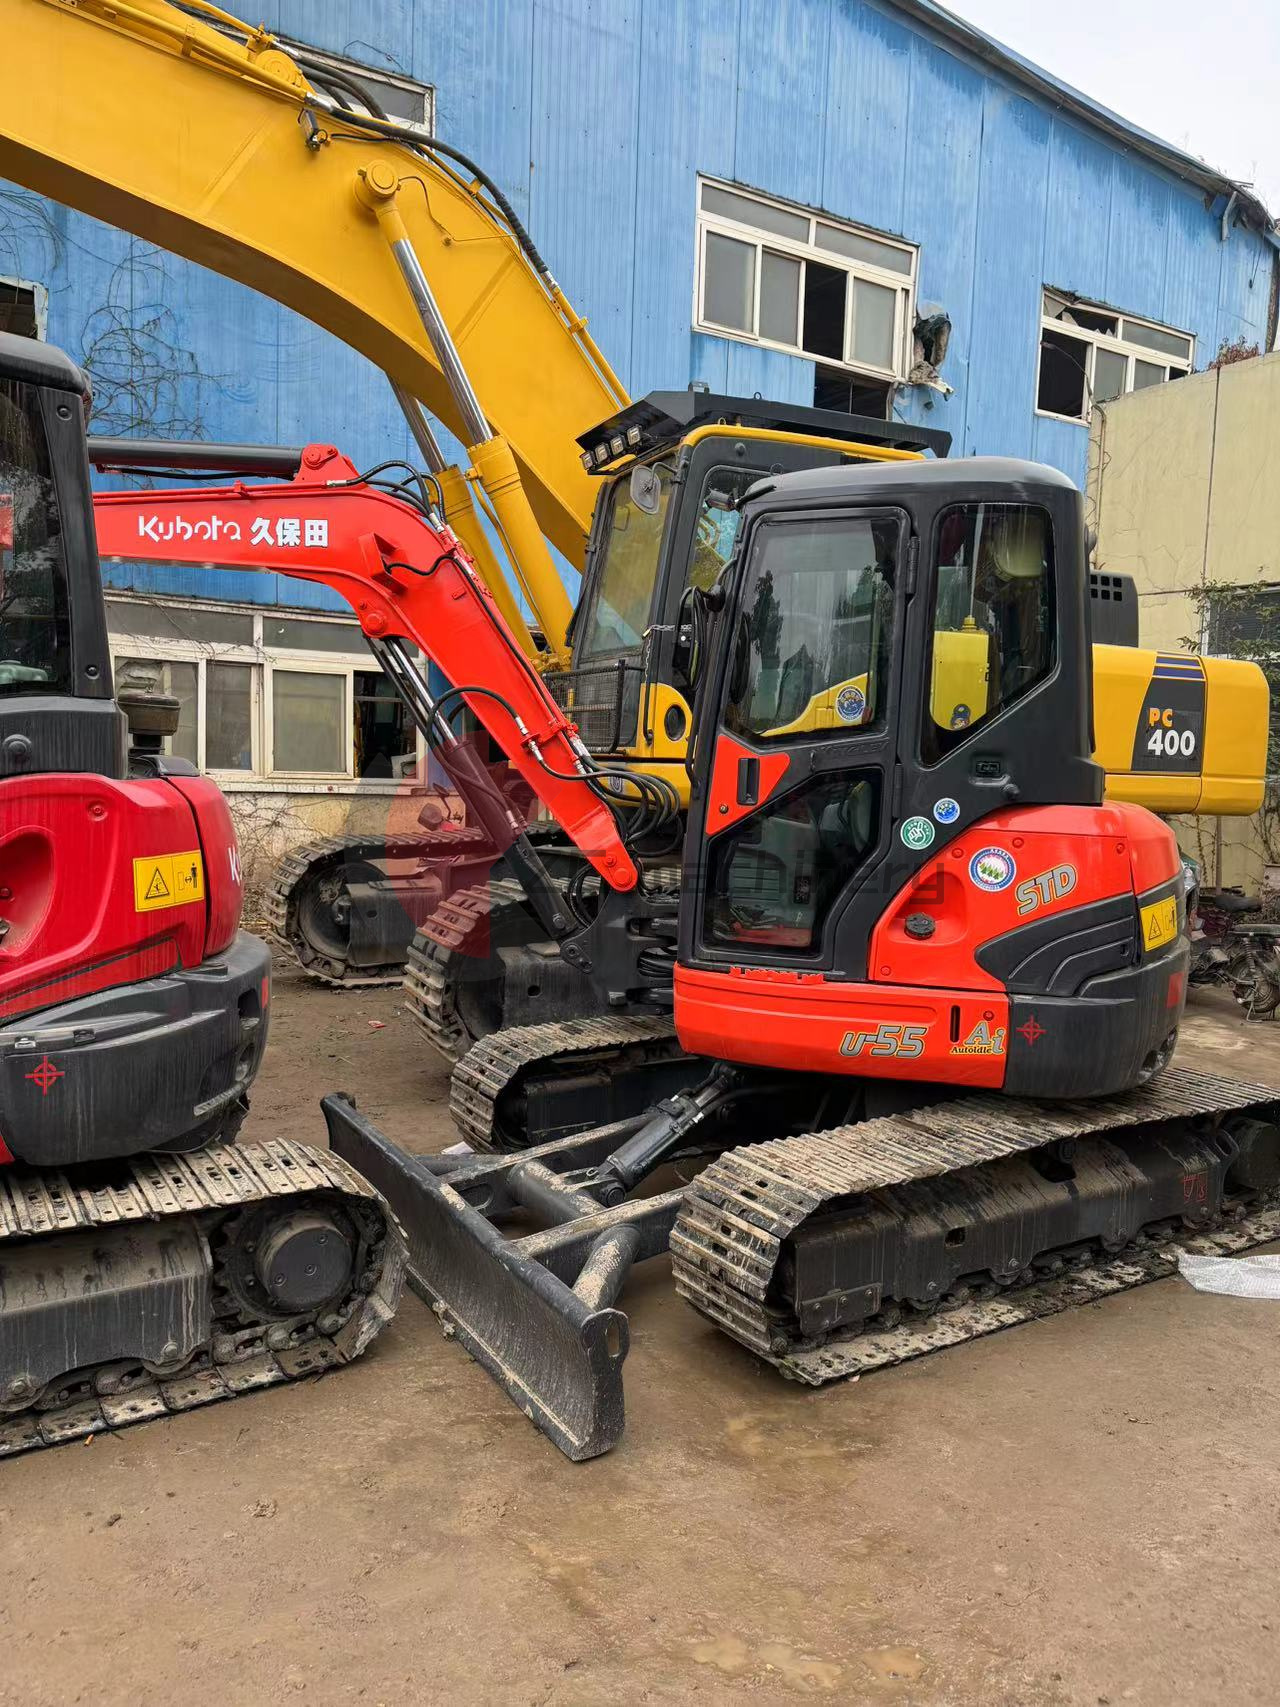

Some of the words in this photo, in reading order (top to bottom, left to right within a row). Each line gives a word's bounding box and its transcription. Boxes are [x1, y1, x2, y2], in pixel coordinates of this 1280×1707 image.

[138, 515, 242, 543] Kubota
[250, 517, 329, 548] 久保田
[1149, 707, 1173, 728] PC
[1147, 729, 1196, 756] 400
[1015, 863, 1078, 915] STD
